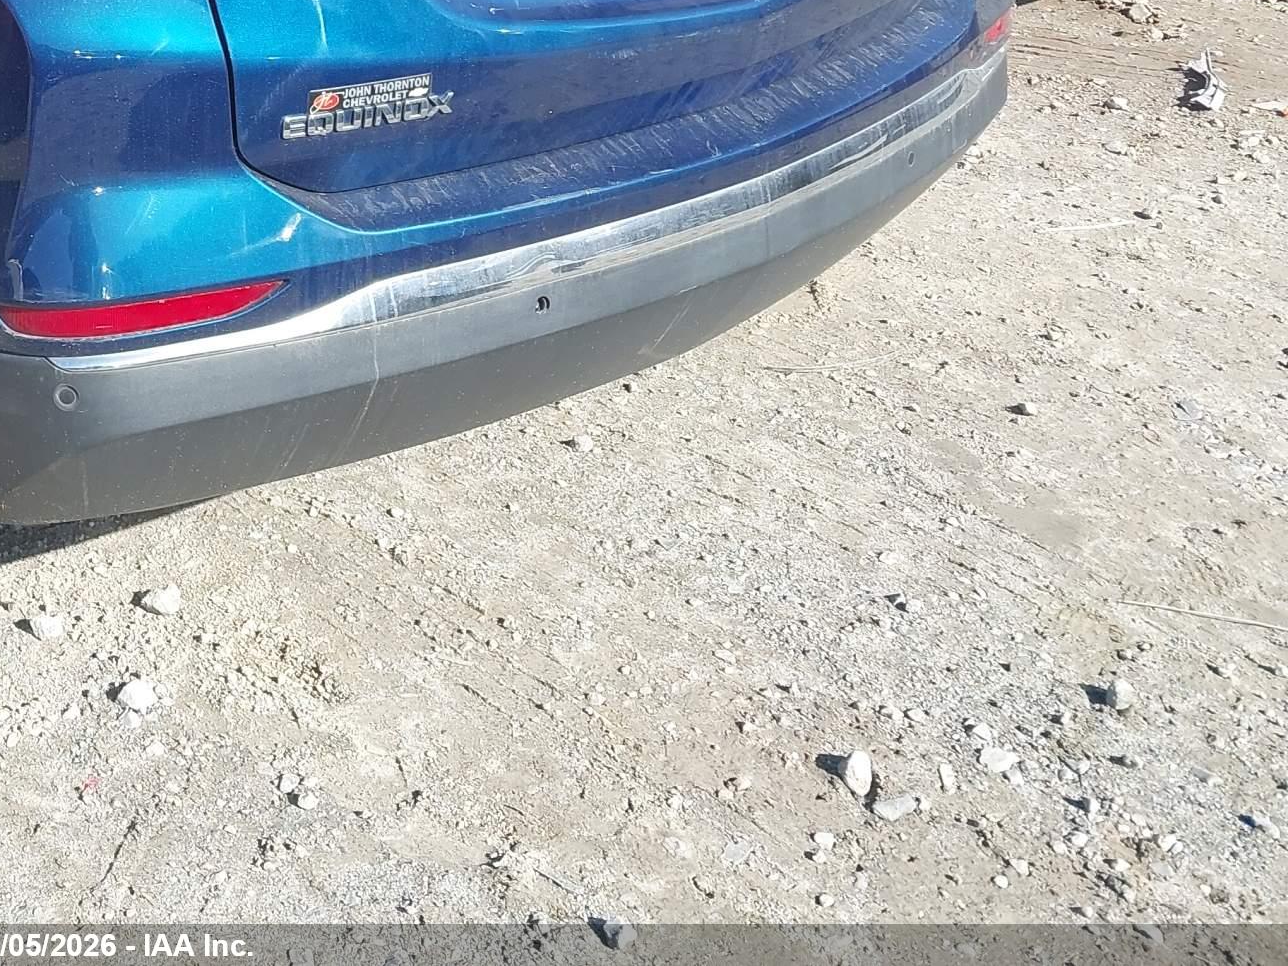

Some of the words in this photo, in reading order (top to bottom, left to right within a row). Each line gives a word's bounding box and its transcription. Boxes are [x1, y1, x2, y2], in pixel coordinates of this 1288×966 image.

[342, 84, 372, 100] JOHN
[373, 74, 430, 94] THORNTON
[342, 89, 409, 109] CHEVROLET
[281, 90, 455, 140] EQUINOX
